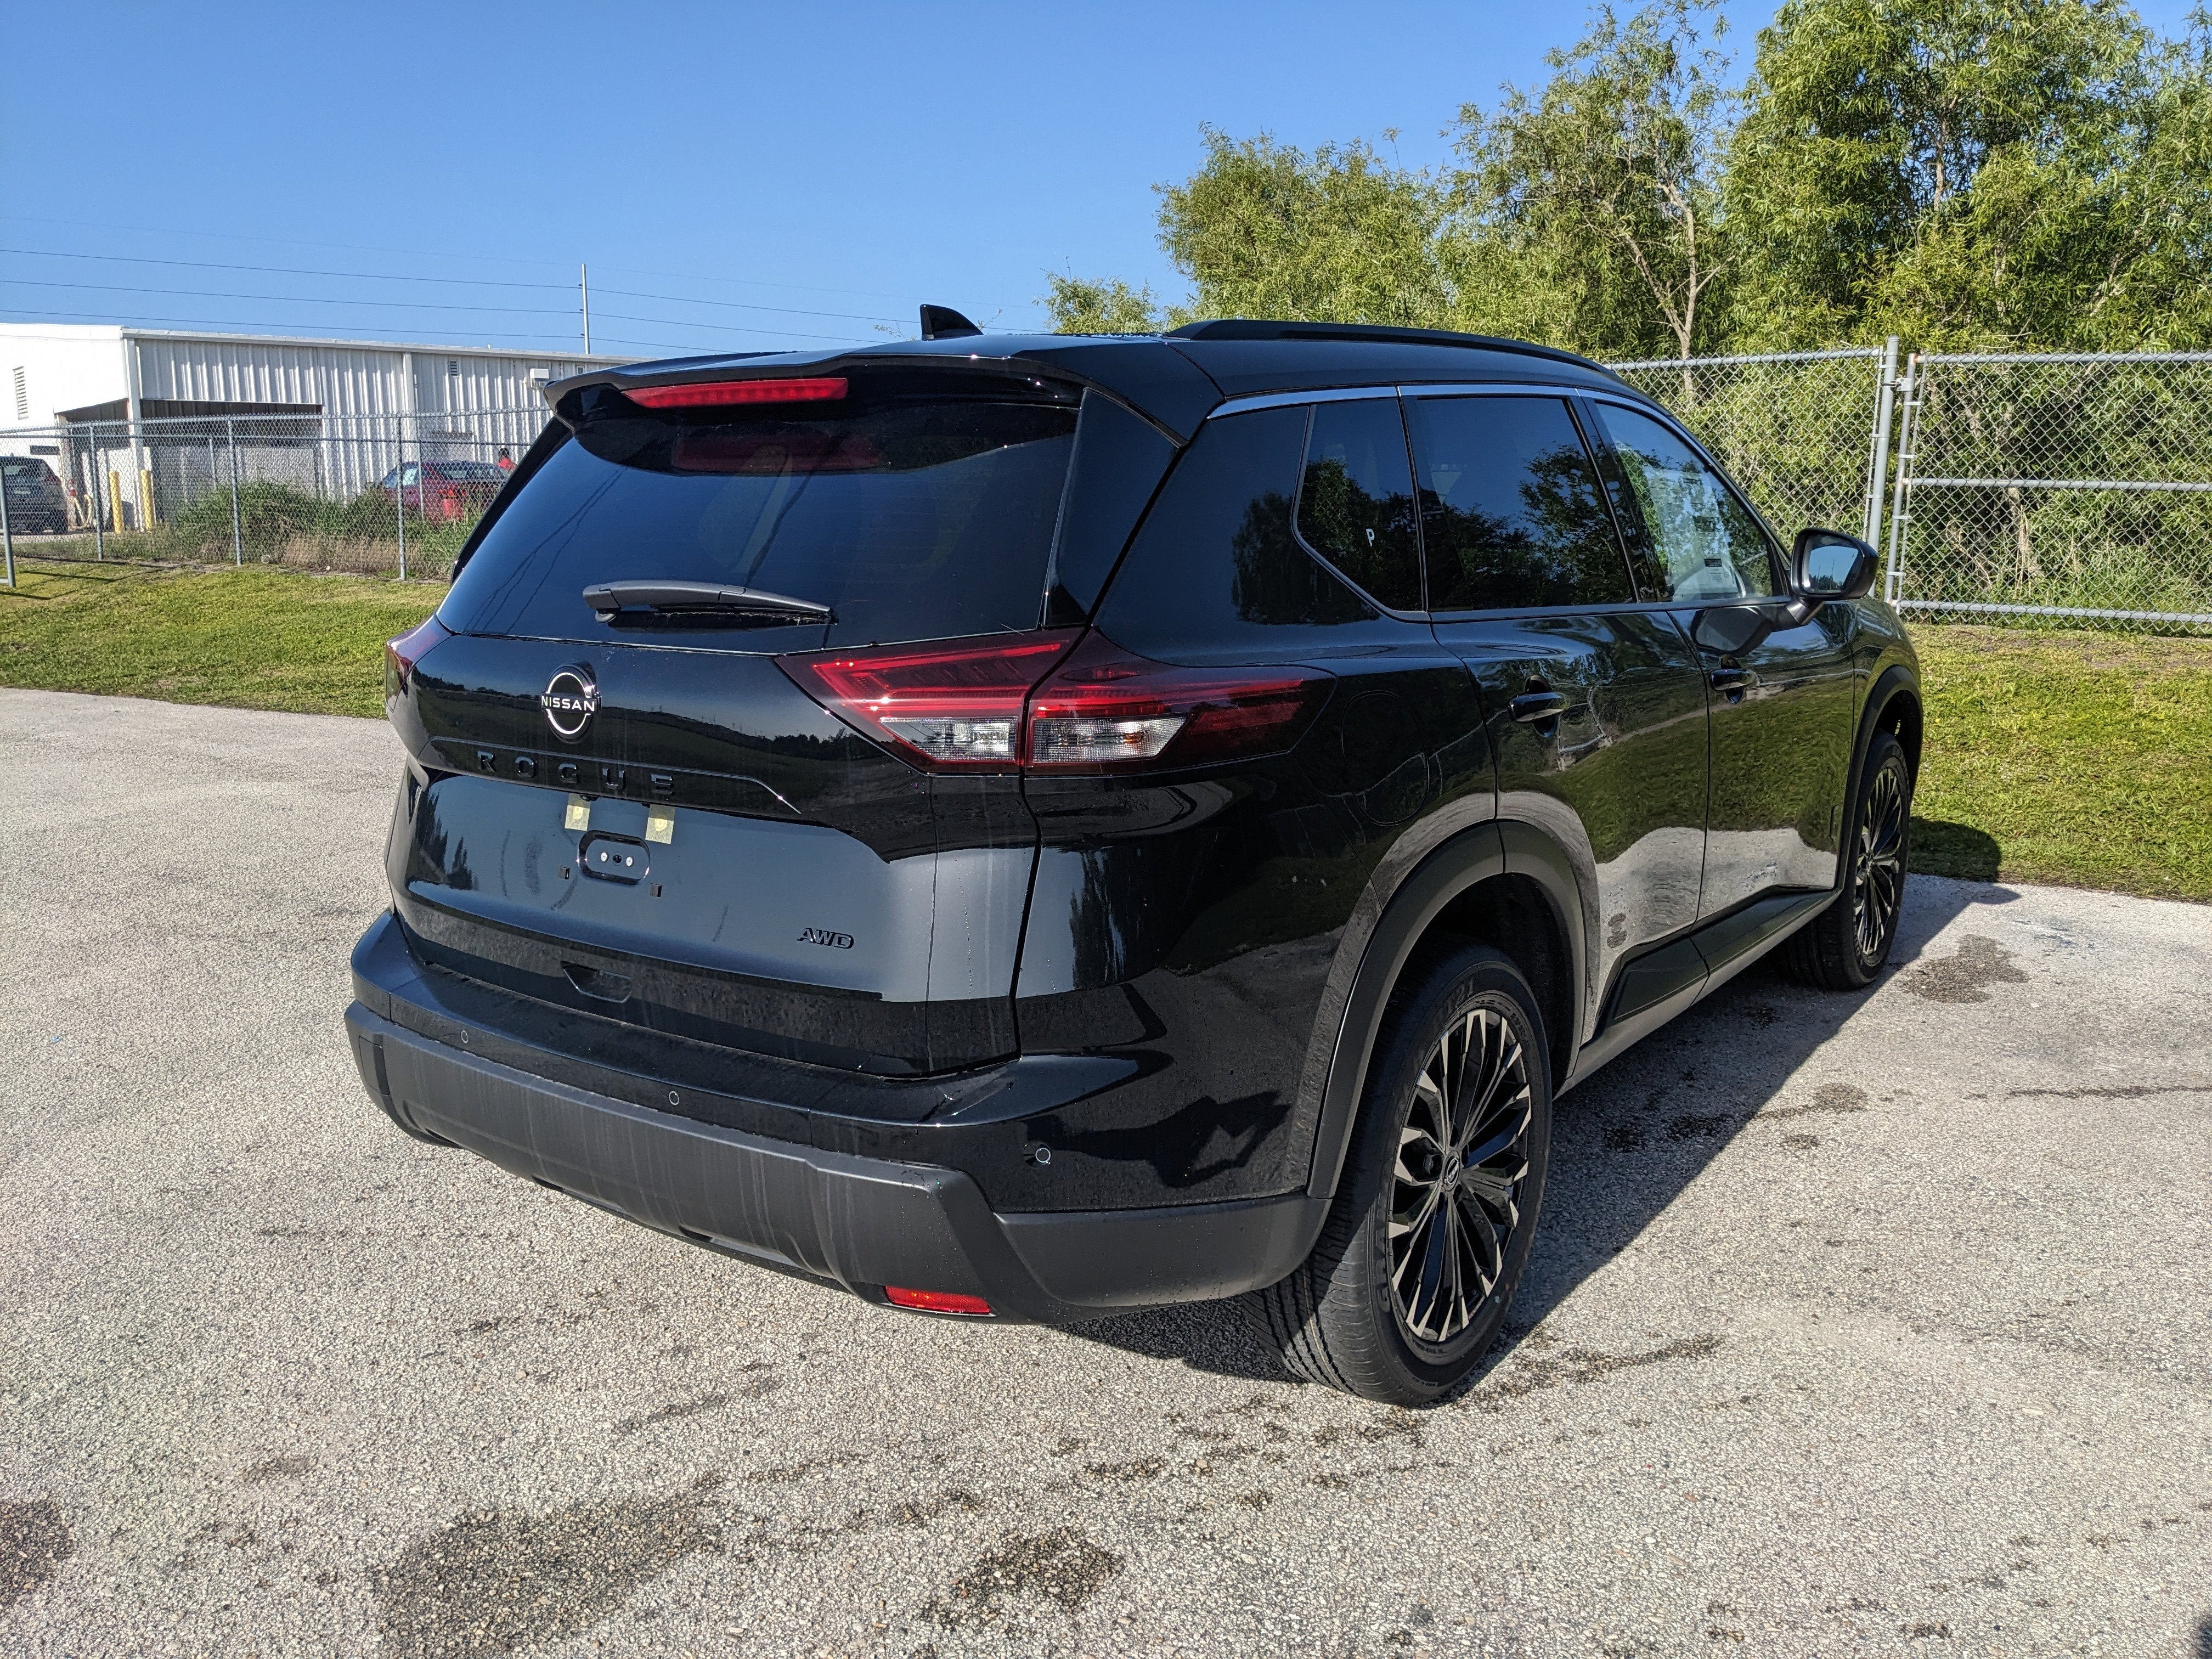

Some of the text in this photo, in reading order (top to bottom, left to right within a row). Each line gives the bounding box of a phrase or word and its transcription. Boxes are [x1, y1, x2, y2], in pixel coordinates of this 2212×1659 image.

[1365, 528, 1375, 547] P
[541, 695, 595, 712] NISSAN
[477, 750, 673, 794] ROGUE
[797, 928, 854, 949] AWD
